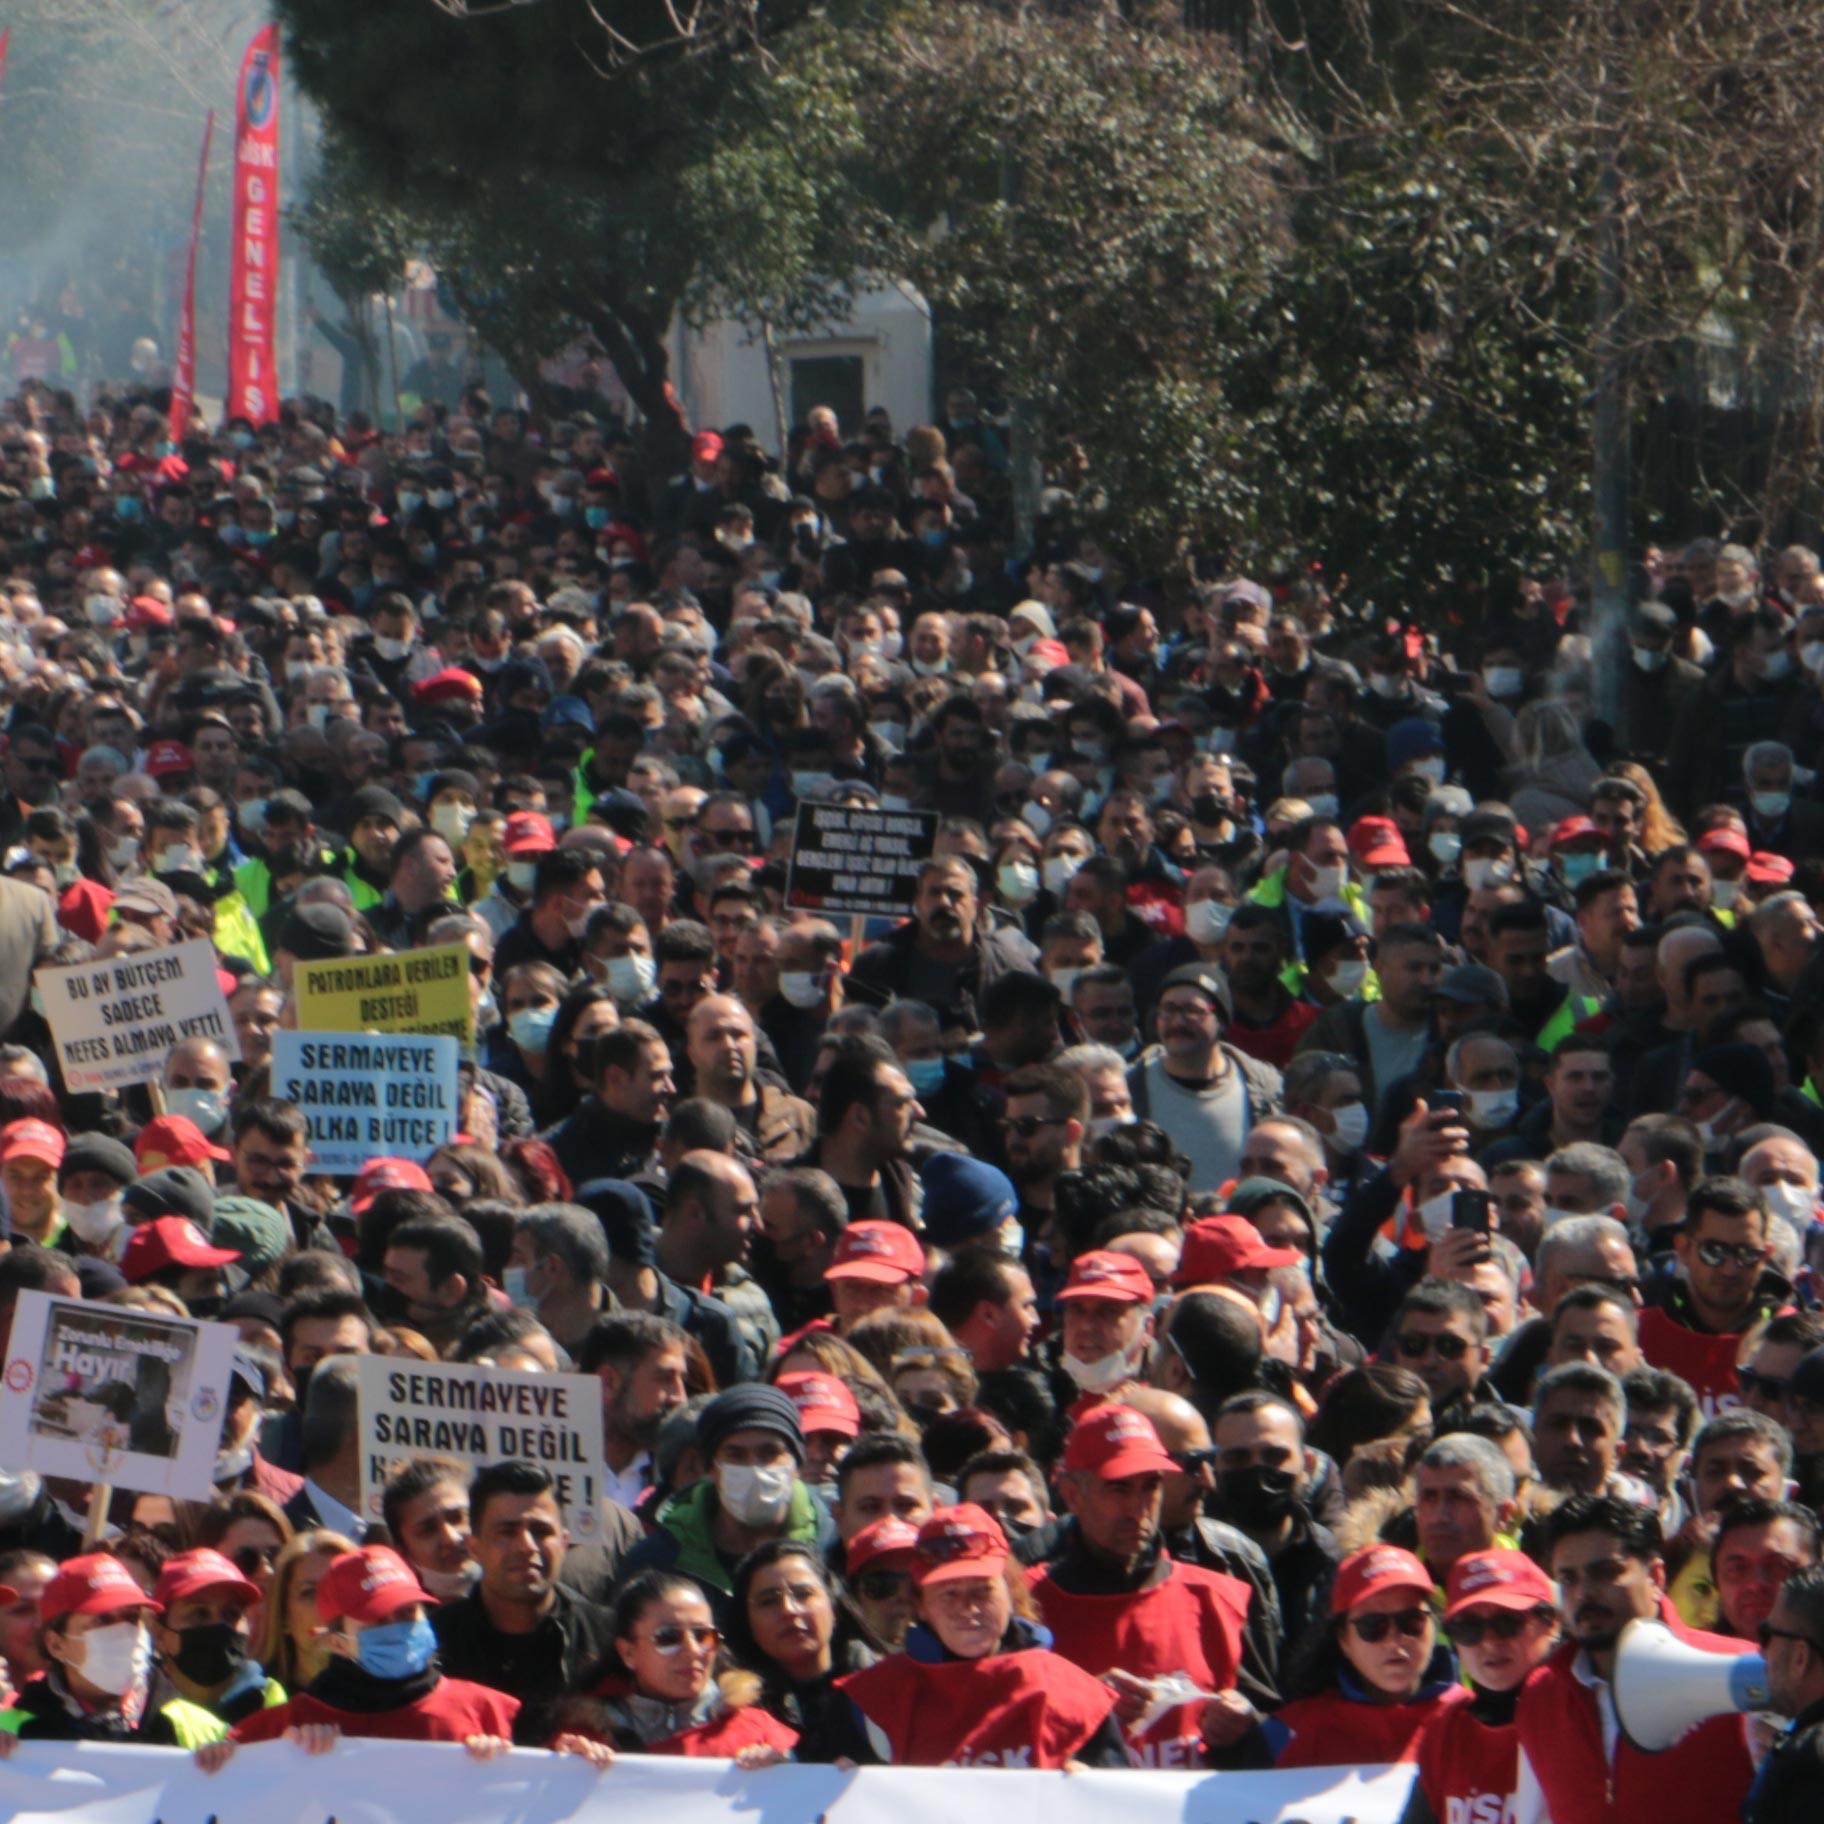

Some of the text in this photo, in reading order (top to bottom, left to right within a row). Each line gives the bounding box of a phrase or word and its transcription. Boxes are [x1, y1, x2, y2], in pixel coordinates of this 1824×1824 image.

[65, 976, 89, 1000] BU
[101, 993, 165, 1027] SADECE
[300, 1042, 436, 1074] SERMAYEYE
[286, 1077, 448, 1111] SARAYA DEĞİL
[368, 1112, 437, 1150] BÜTÇE
[389, 1372, 568, 1419] SERMAYEYE
[375, 1412, 588, 1464] SARAYA DEĞİL
